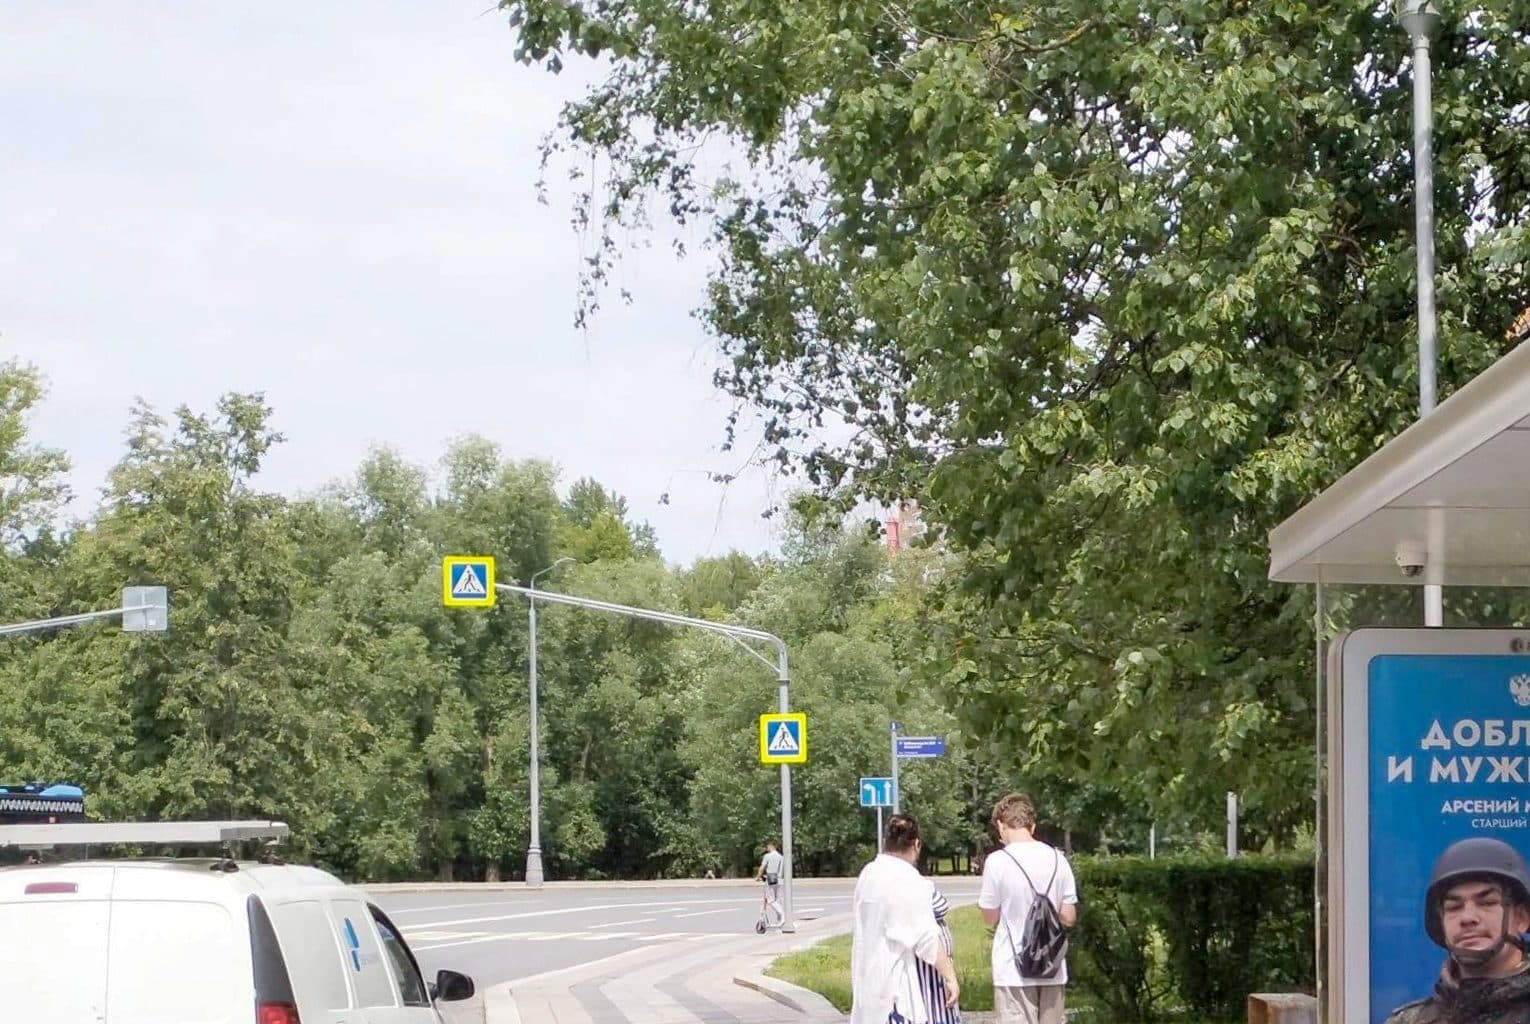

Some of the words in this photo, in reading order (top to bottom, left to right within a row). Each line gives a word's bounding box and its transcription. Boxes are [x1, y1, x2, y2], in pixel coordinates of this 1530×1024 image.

[1388, 756, 1413, 783] И
[1441, 796, 1520, 813] АРСЕНИЙ
[1471, 816, 1527, 829] СТАРШИЙ
